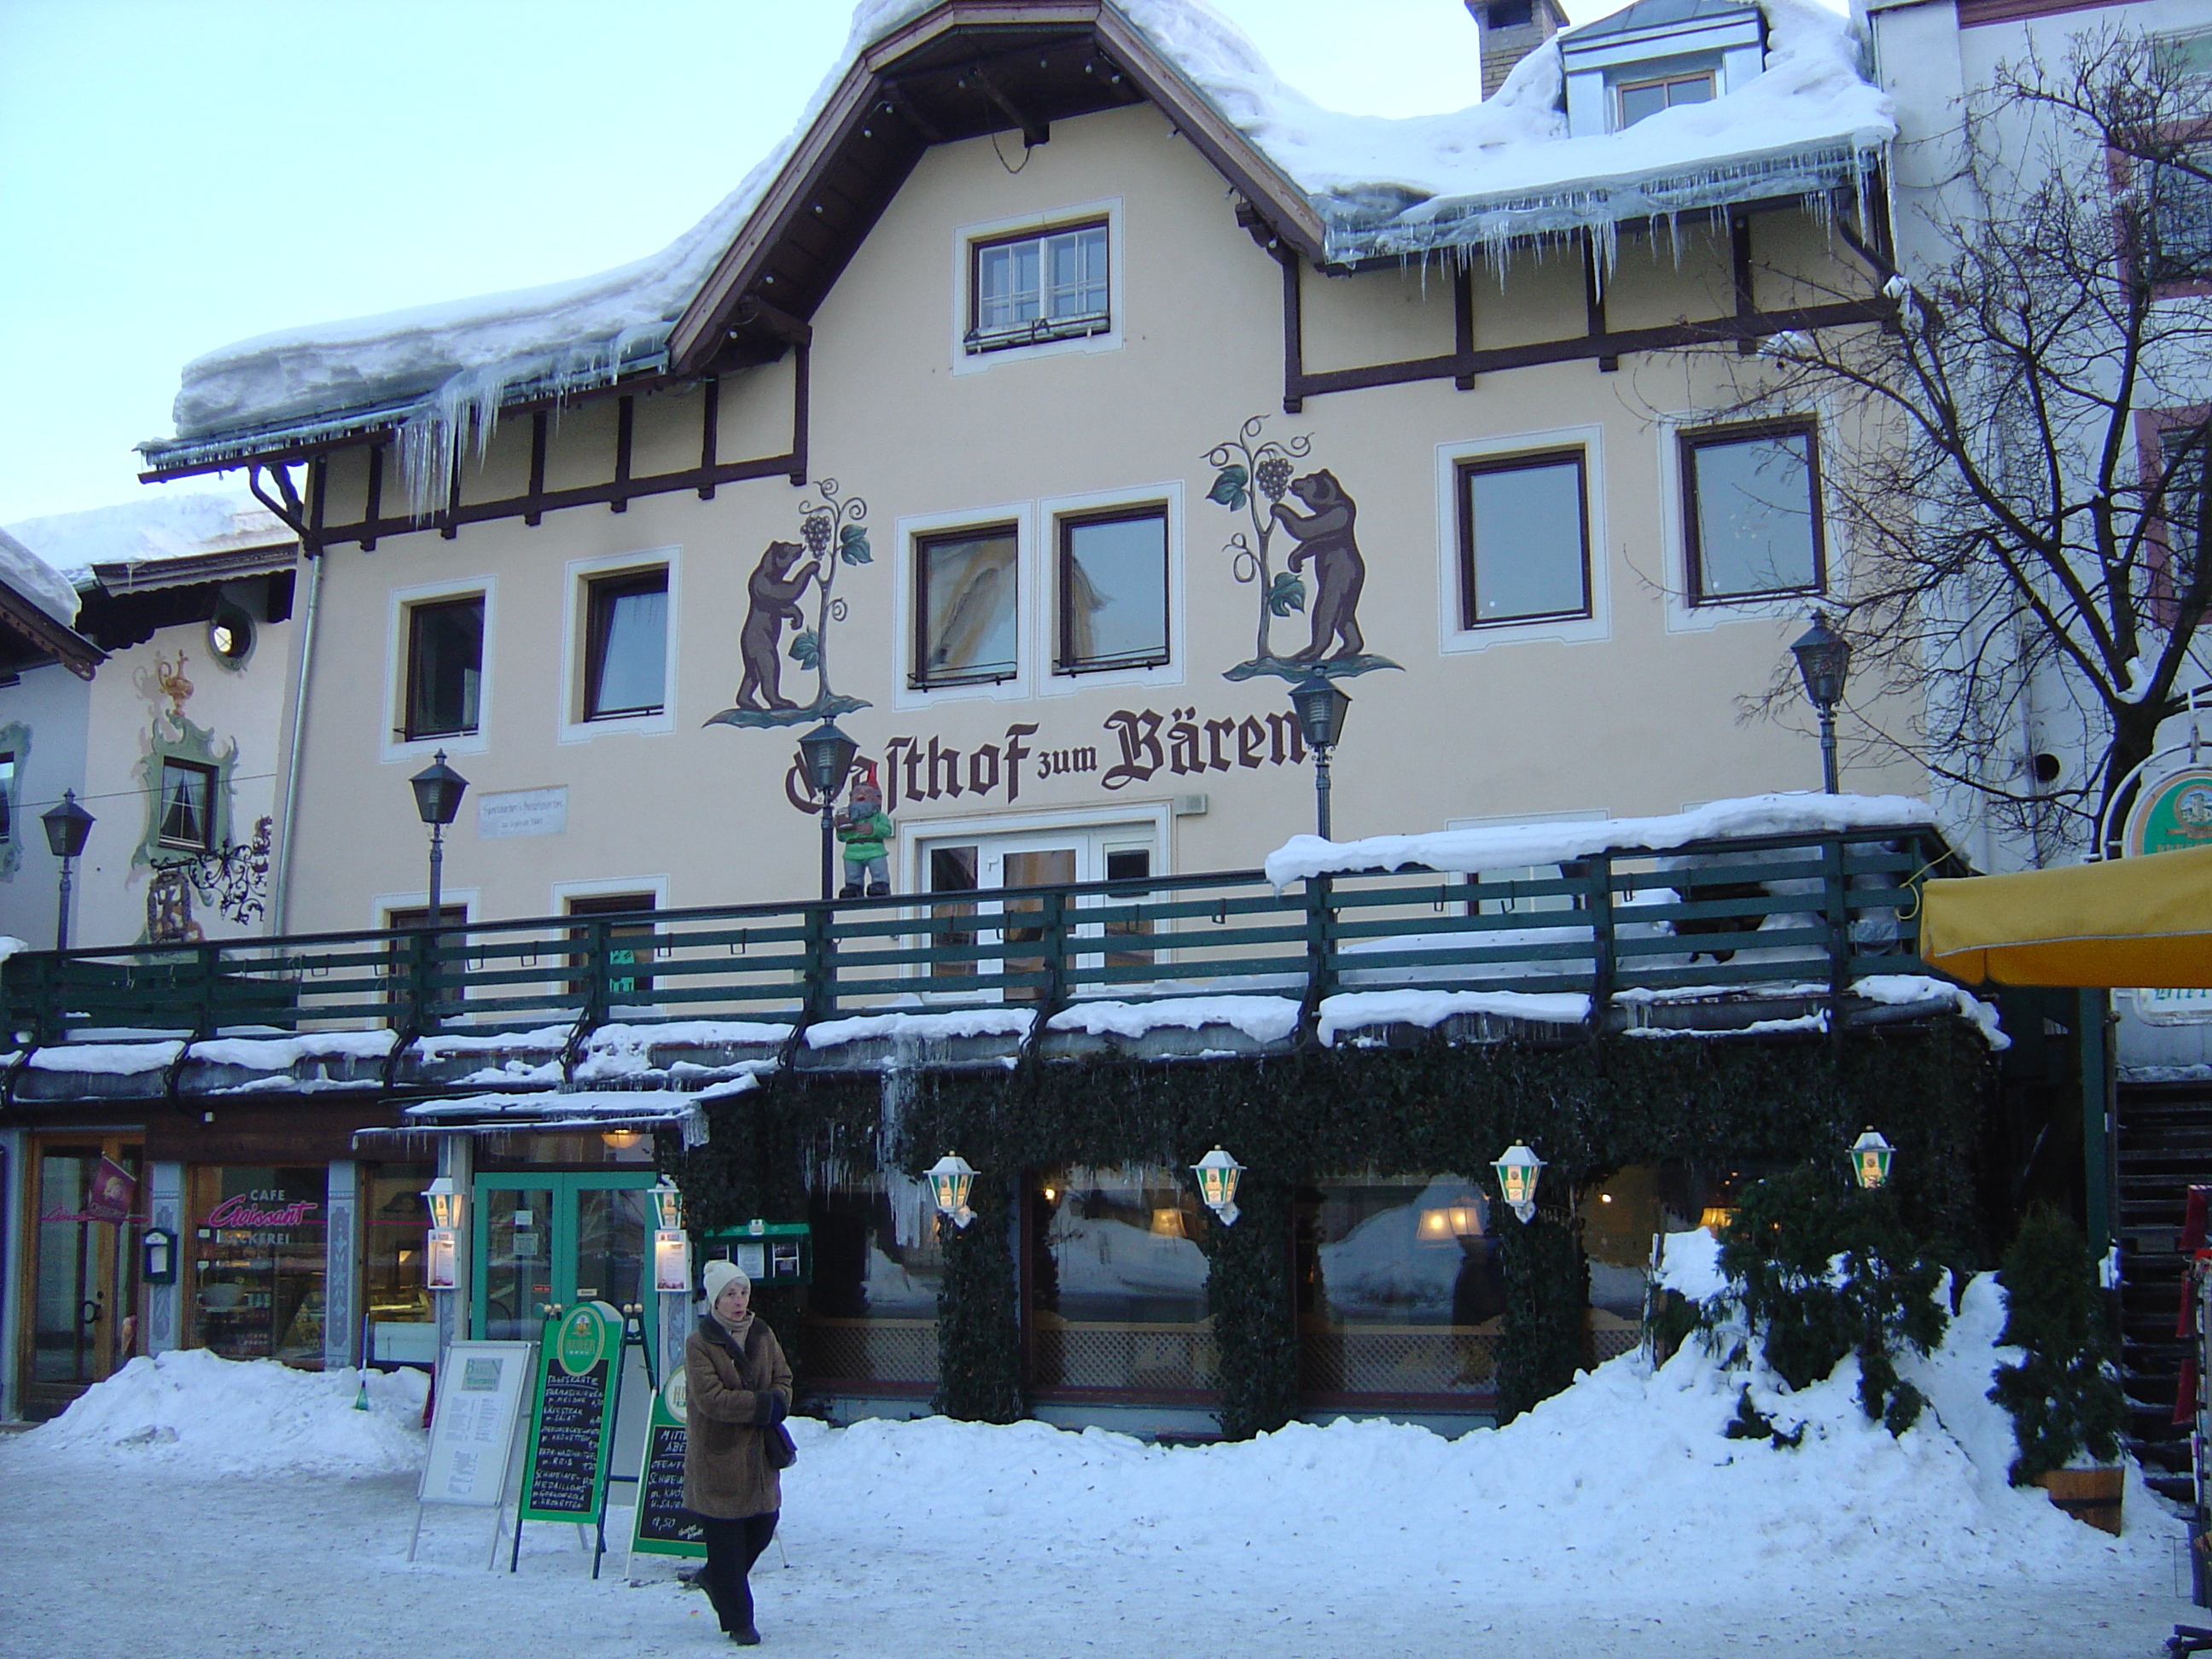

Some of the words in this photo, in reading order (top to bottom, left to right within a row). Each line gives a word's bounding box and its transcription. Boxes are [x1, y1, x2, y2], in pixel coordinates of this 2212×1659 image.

[1037, 747, 1098, 780] zum
[1101, 706, 1311, 790] Bären
[250, 1189, 285, 1202] CAFE
[209, 1194, 318, 1227] Croissant
[661, 1429, 686, 1441] MITT
[665, 1441, 687, 1452] ABE
[651, 1460, 685, 1469] OFENF
